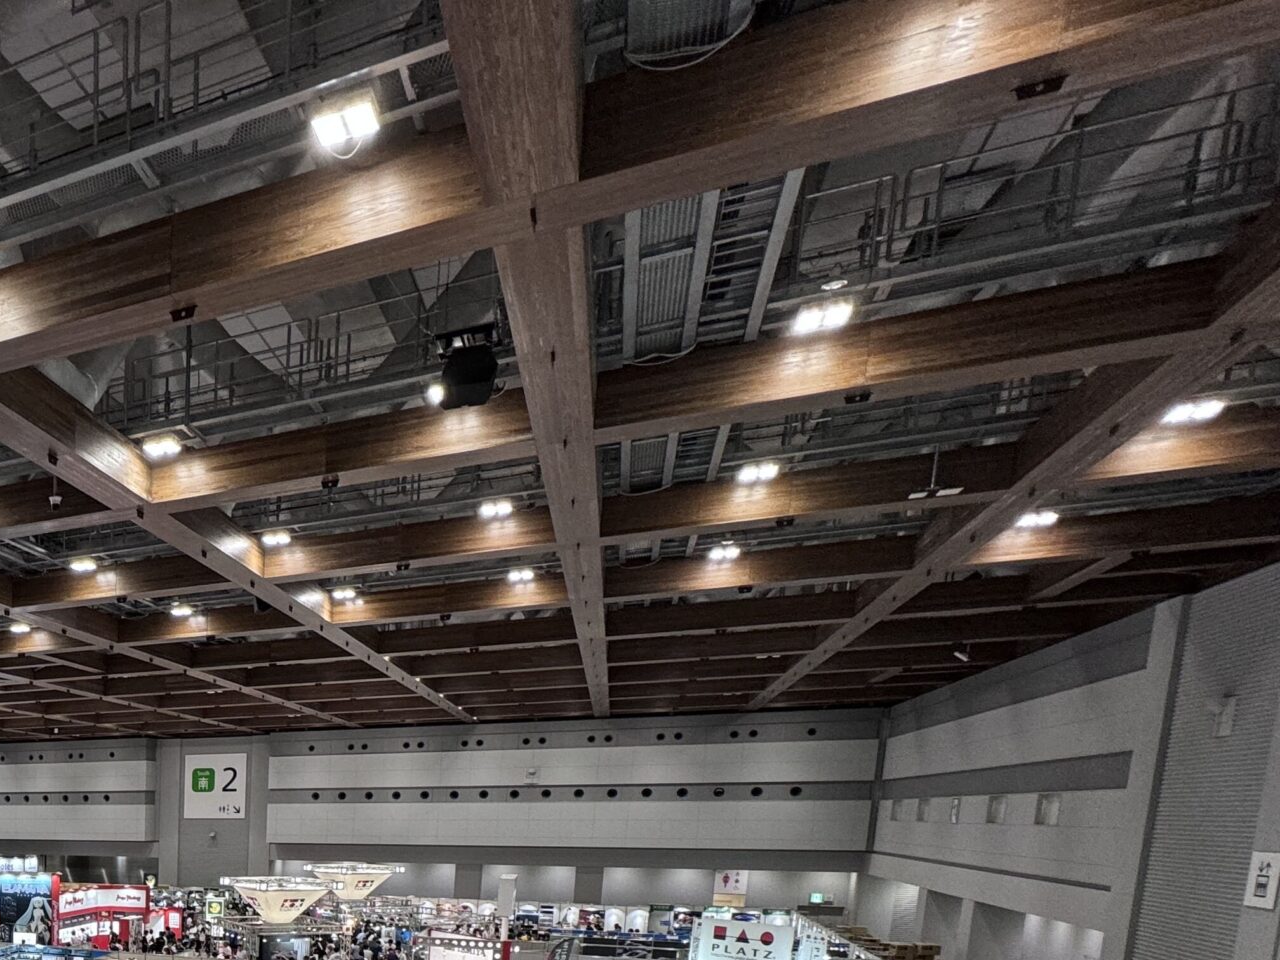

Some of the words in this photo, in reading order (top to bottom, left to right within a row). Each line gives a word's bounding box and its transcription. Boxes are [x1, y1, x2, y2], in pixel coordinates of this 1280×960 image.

[198, 777, 209, 790] 南
[222, 767, 237, 792] 2
[712, 943, 772, 959] PLATZ
